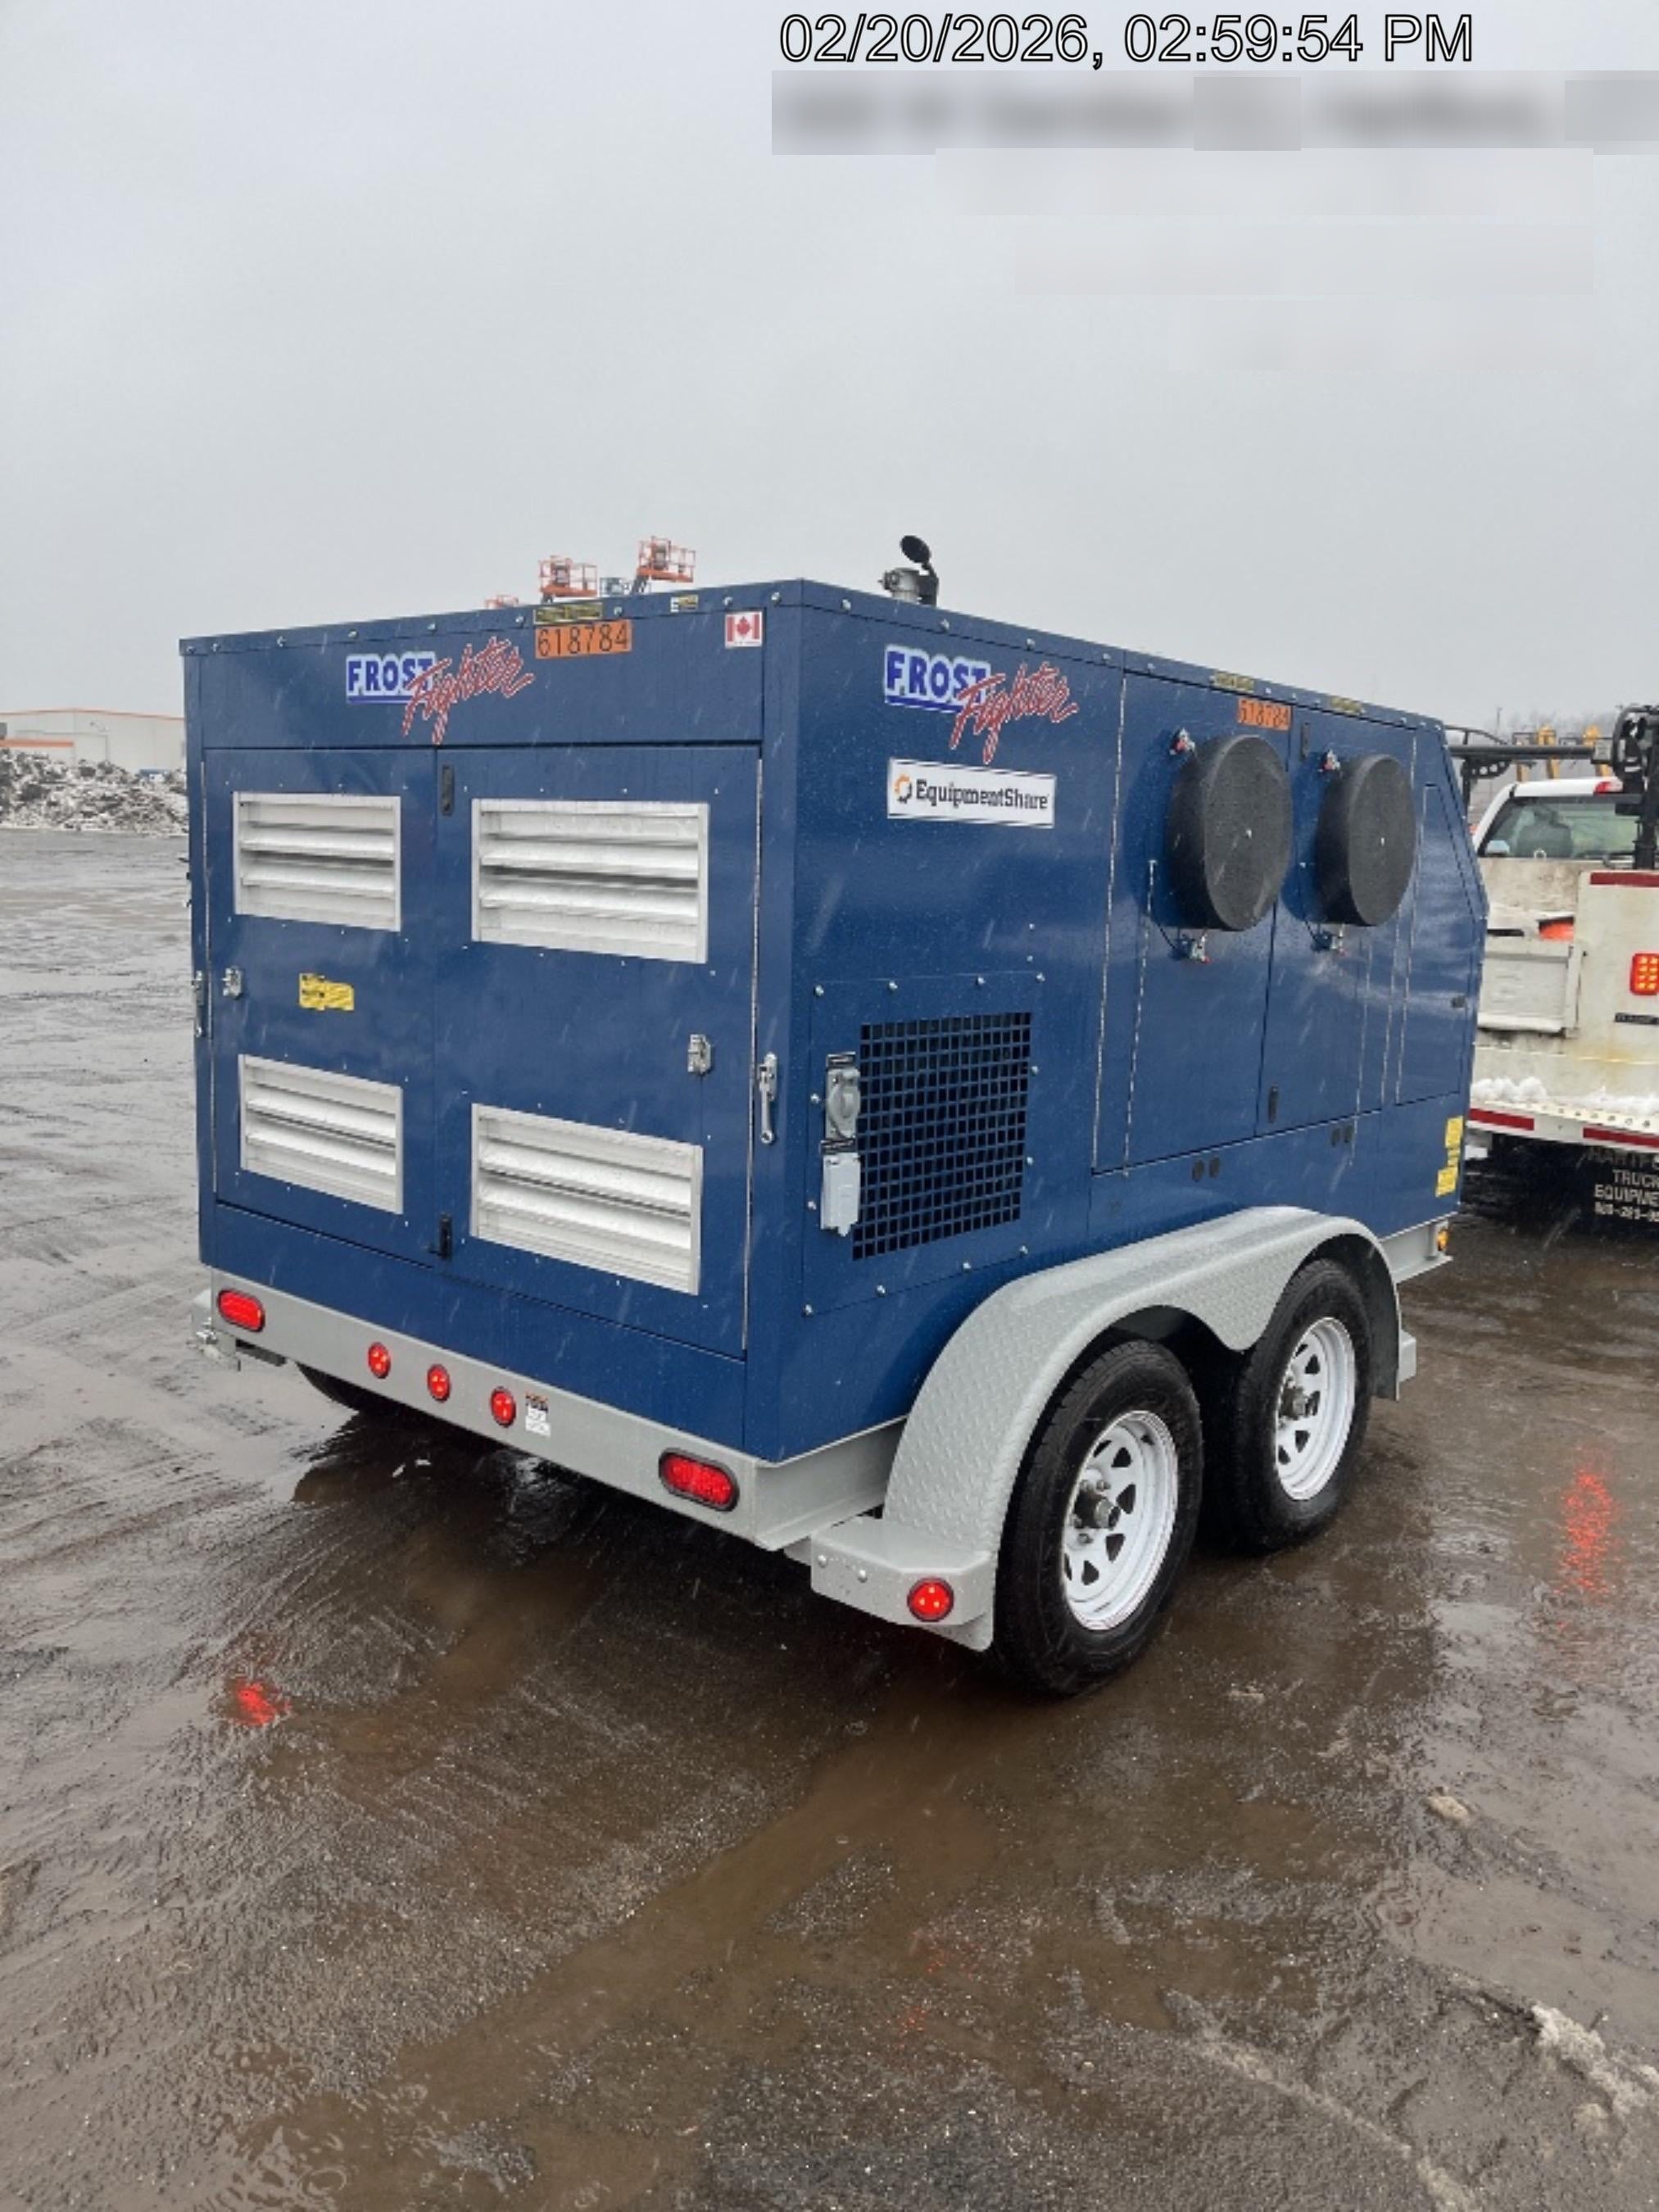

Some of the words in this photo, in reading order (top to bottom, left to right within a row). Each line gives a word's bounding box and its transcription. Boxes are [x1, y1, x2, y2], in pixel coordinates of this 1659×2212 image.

[537, 623, 628, 656] 618784
[347, 656, 434, 693] FROST
[886, 650, 988, 704] FROST
[916, 778, 1049, 809] EquipmentShare
